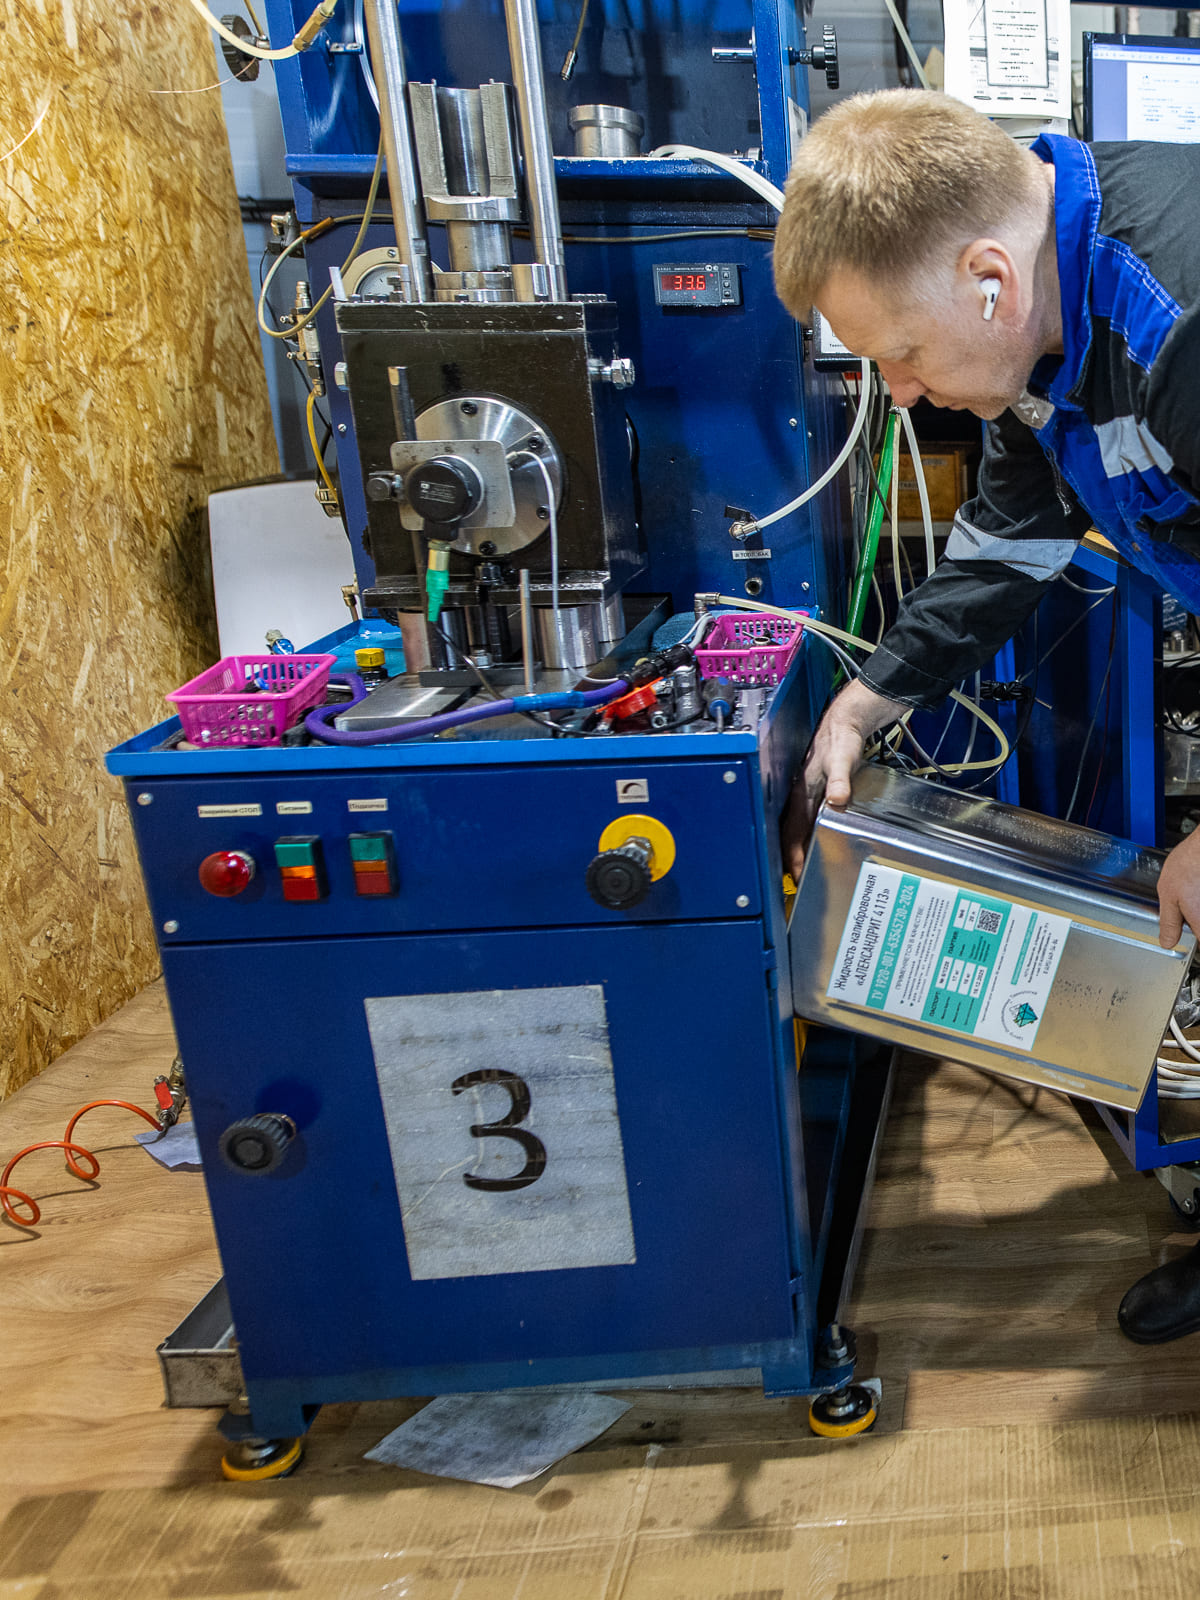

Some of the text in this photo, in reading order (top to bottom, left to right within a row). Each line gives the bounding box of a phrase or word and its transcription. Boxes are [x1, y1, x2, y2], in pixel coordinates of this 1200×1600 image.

[674, 275, 706, 290] 33.6
[835, 874, 877, 990] Жидкость калибровочная
[855, 917, 882, 985] «АЛЕКСАНДРИТ
[451, 1068, 548, 1193] 3
